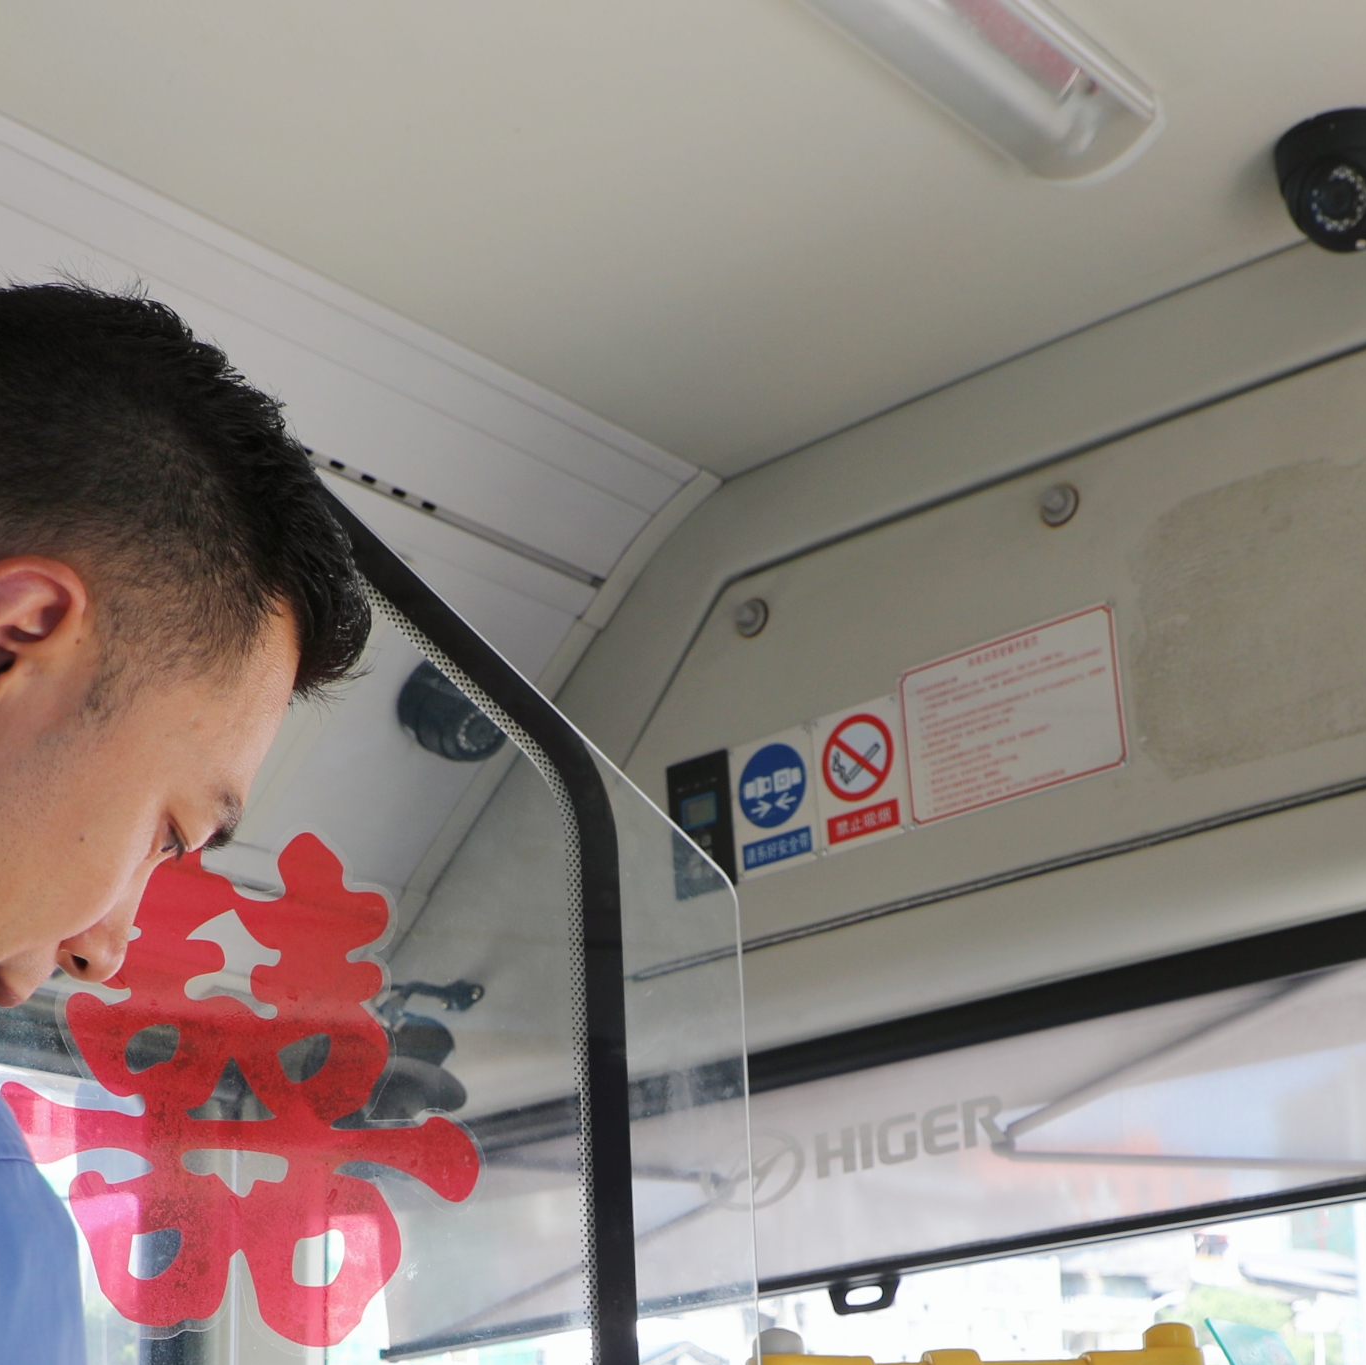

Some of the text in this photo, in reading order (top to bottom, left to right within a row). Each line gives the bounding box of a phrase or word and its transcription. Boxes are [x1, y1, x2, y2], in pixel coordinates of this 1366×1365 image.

[836, 806, 892, 838] 禁止吸烟
[814, 1096, 1007, 1180] HIGER
